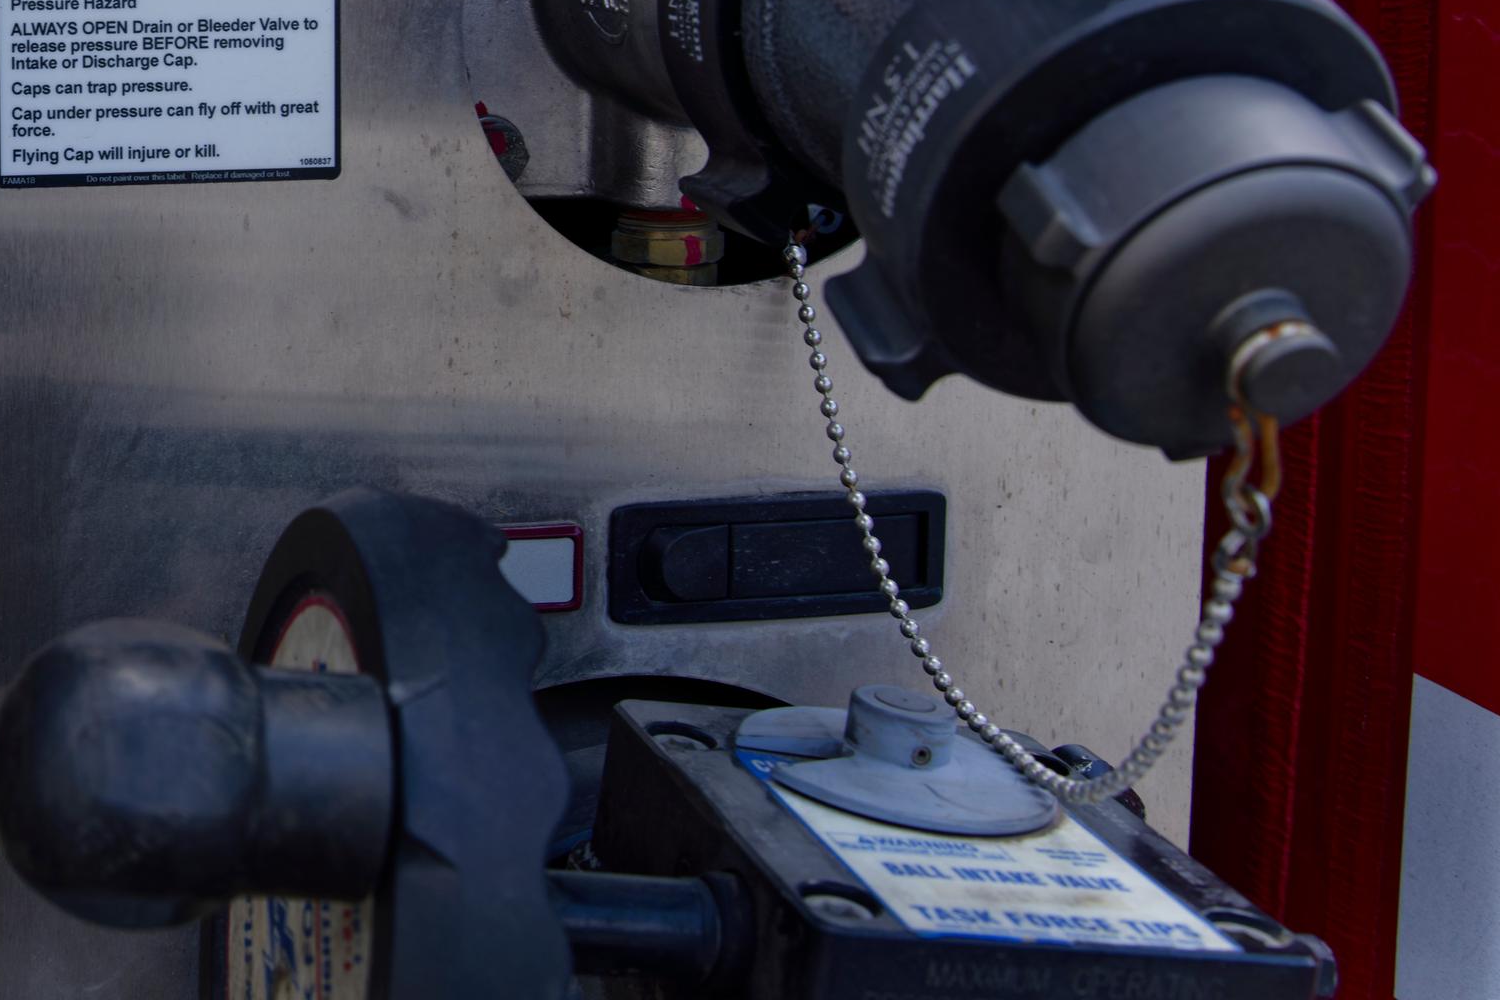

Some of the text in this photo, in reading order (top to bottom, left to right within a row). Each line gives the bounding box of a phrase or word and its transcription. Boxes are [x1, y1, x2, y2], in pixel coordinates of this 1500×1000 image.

[11, 17, 317, 36] ALWAYS OPEN Drain or Bleeder Valve to
[11, 35, 284, 55] release pressure BEFORE removing
[12, 54, 197, 70] Intake or Discharge Cap.
[12, 80, 192, 97] Caps can trap pressure.
[12, 101, 318, 122] Cap under pressure can fly off with great
[12, 124, 55, 137] force.
[13, 145, 219, 166] Flying Cap will injure or kill.
[2, 177, 36, 185] FAMA18
[86, 174, 98, 183] Do
[100, 174, 112, 183] not
[113, 174, 132, 183] paint
[152, 172, 165, 180] this
[192, 172, 222, 181] Replace
[230, 170, 265, 180] damaged
[883, 860, 1132, 893] BALL INTAKE VALVE
[910, 904, 999, 928] TASK
[1008, 911, 1125, 936] FORCE
[1129, 918, 1203, 941] TIPS
